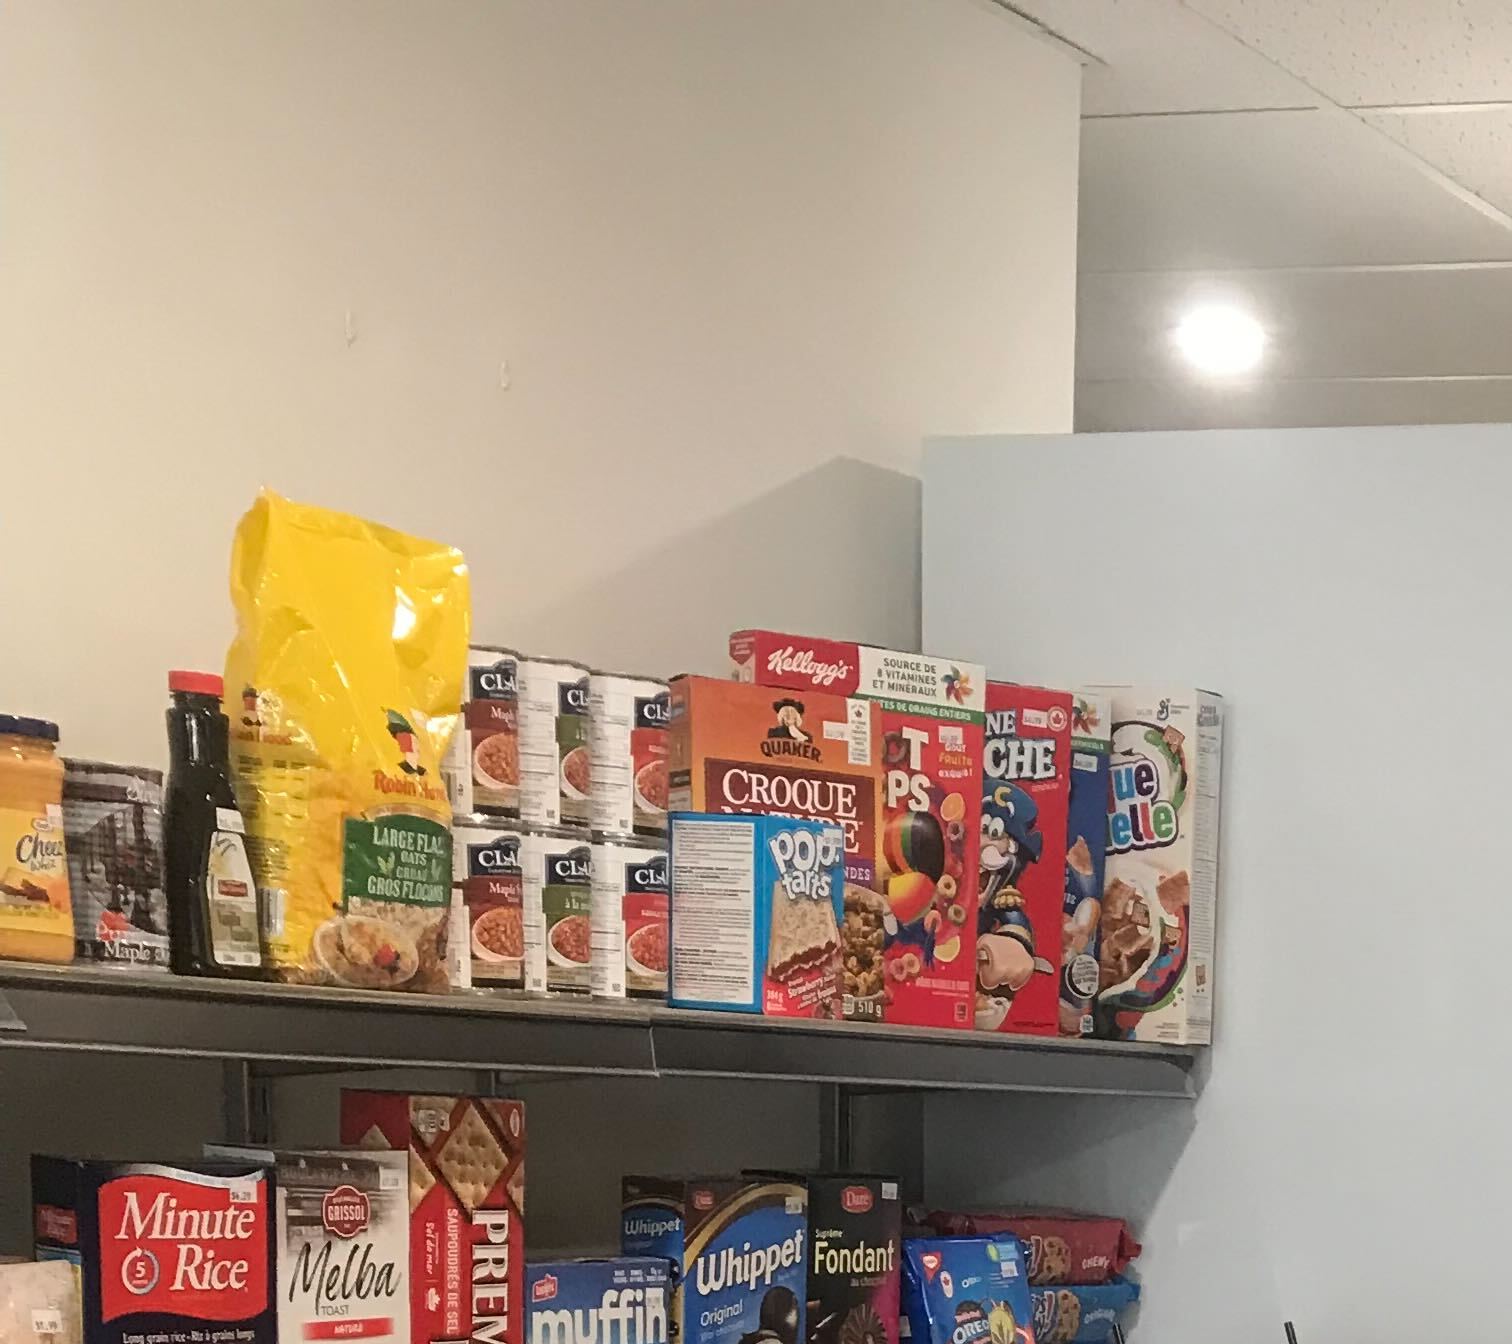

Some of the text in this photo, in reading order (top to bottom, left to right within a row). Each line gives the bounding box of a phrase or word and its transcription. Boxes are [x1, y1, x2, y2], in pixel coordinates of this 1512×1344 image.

[767, 646, 850, 687] Kellogg's
[883, 656, 937, 675] SOURCE DE
[872, 679, 884, 689] ET
[886, 671, 937, 686] VITAMINES
[936, 706, 972, 722] ENTIERS
[760, 738, 822, 763] QUAKER
[983, 737, 1057, 780] CHE
[722, 768, 857, 819] CROQUE
[372, 826, 415, 851] LARGE
[400, 851, 427, 867] OATS
[367, 876, 401, 898] GROS
[782, 870, 833, 900] tarts
[104, 941, 150, 963] Maple
[857, 1001, 873, 1014] 510
[114, 1191, 256, 1240] Minute
[327, 1206, 366, 1221] GRISSOL
[624, 1216, 681, 1237] Whippet
[135, 1244, 250, 1292] 5 Rice
[696, 1228, 804, 1296] Whippet
[814, 1239, 895, 1275] Fondant
[1081, 1256, 1110, 1270] CHEWY
[288, 1240, 402, 1316] Melba
[321, 1304, 350, 1316] TOAST
[447, 1290, 459, 1309] DE
[447, 1312, 460, 1335] SEL
[700, 1299, 743, 1327] Original
